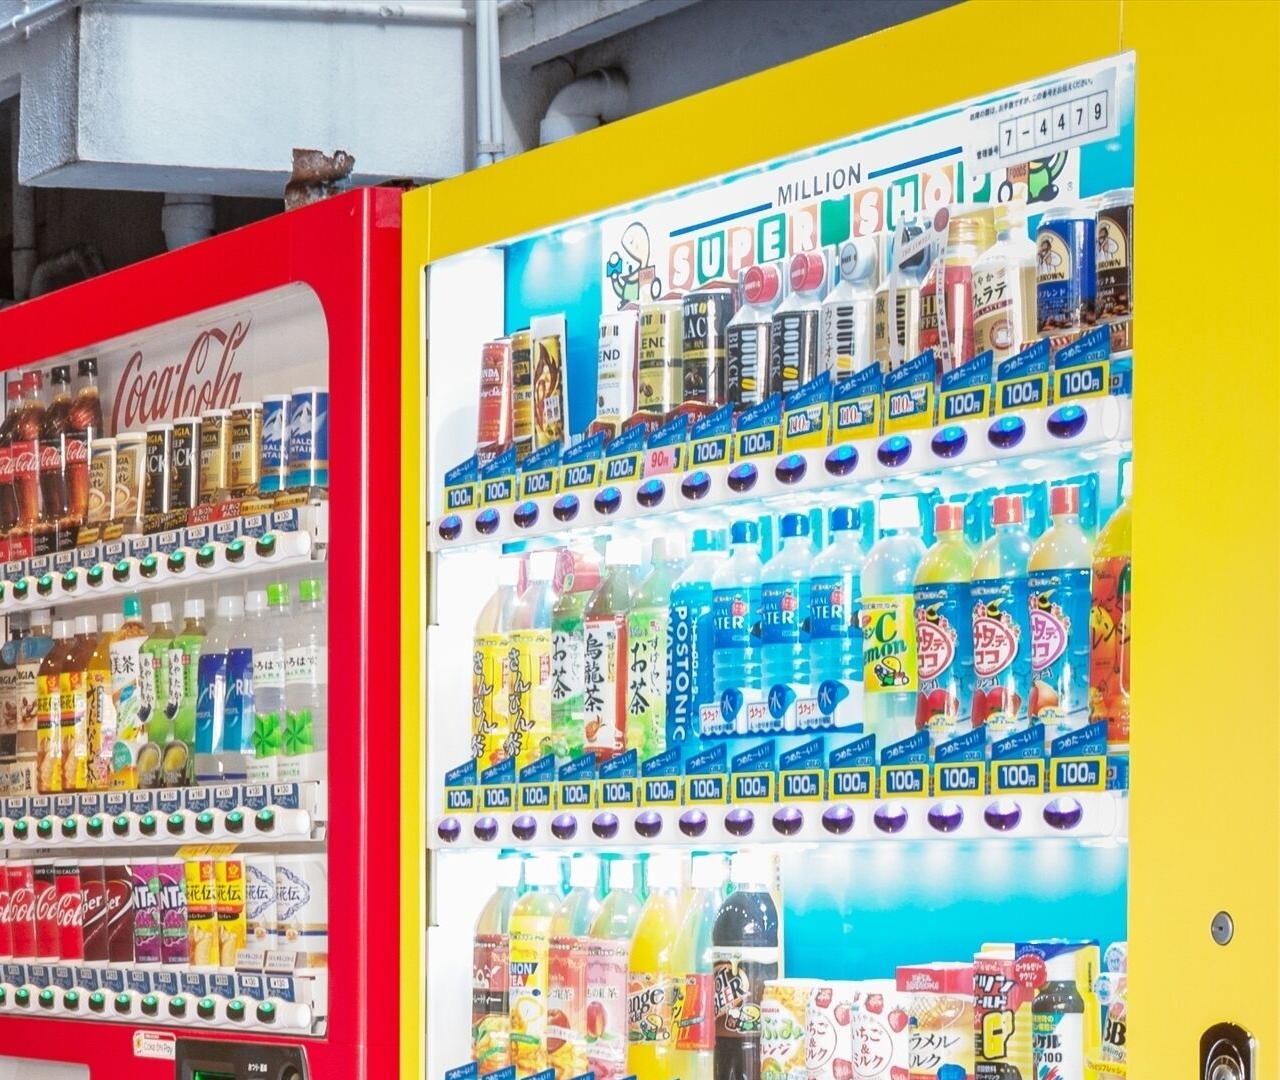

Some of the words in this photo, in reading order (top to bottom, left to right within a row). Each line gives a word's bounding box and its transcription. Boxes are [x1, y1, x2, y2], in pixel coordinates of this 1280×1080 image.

[778, 163, 862, 206] MILLION
[670, 205, 818, 291] SUPER
[772, 320, 782, 380] BLACK
[728, 331, 739, 391] BLACK
[1064, 370, 1101, 394] 100円
[949, 394, 981, 413] 100円
[1006, 383, 1039, 406] 100円
[696, 441, 723, 461] 100円
[743, 432, 771, 453] 100円
[609, 458, 633, 479] 100円
[651, 451, 670, 469] 90円
[528, 473, 550, 493] 100円
[568, 465, 592, 487] 100円
[449, 489, 471, 506] 100円
[487, 482, 509, 500] 100円
[584, 633, 605, 713] 烏龍茶
[628, 642, 651, 716] お茶
[672, 605, 690, 742] POSTONIC
[837, 773, 867, 793] 100円
[891, 771, 920, 791] 100円
[945, 768, 976, 788] 100円
[1002, 765, 1036, 787] 100円
[1061, 762, 1096, 785] 100円
[565, 785, 588, 803] 100円
[606, 783, 631, 802] 100円
[649, 780, 674, 800] 100円
[694, 779, 720, 799] 100円
[740, 777, 767, 797] 100円
[788, 775, 817, 795] 100円
[450, 790, 471, 807] 100円
[487, 788, 509, 806] 100円
[525, 787, 547, 805] 100円
